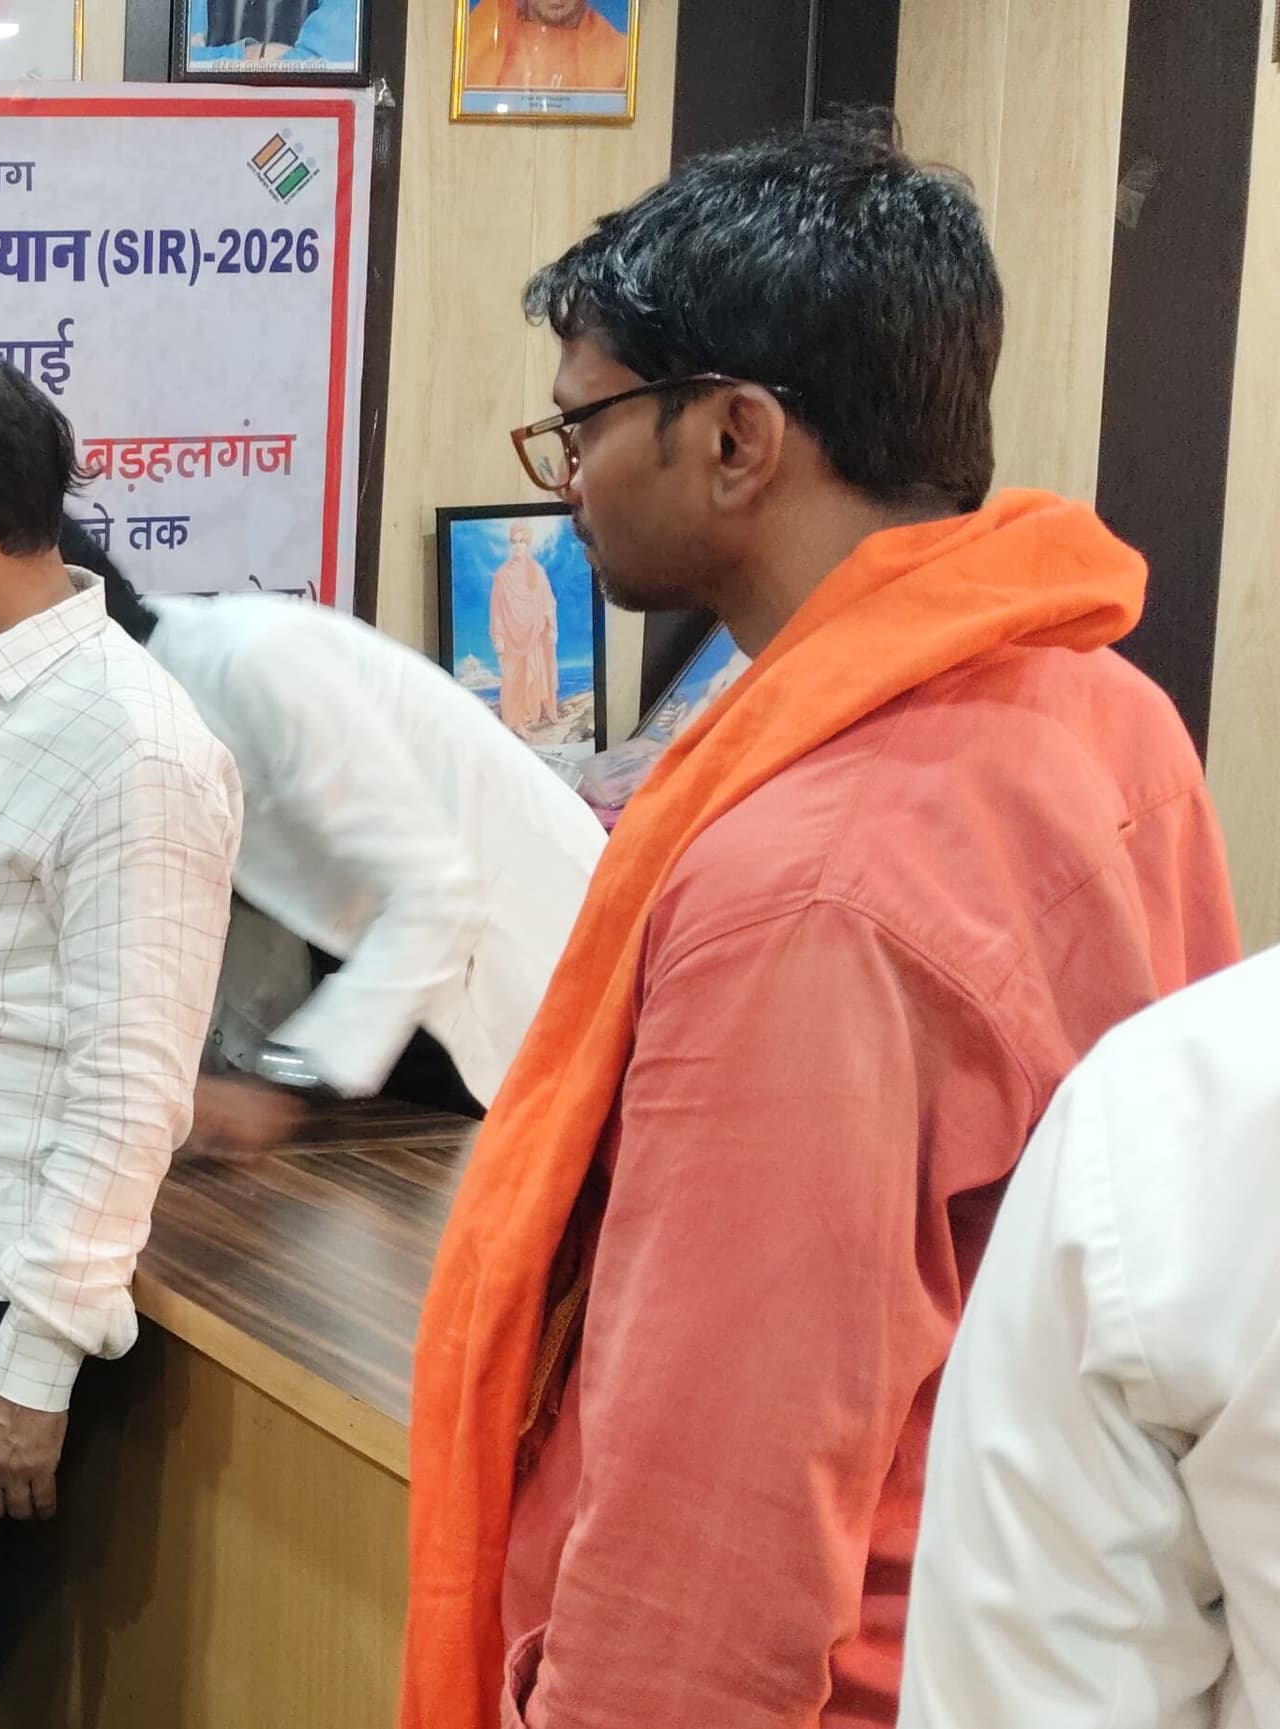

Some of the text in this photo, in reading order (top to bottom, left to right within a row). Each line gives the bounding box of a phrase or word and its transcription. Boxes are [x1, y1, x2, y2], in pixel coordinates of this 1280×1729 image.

[97, 226, 321, 287] (SIR)-2026
[82, 418, 297, 494] बड़हलगंज
[127, 516, 190, 550] तक
